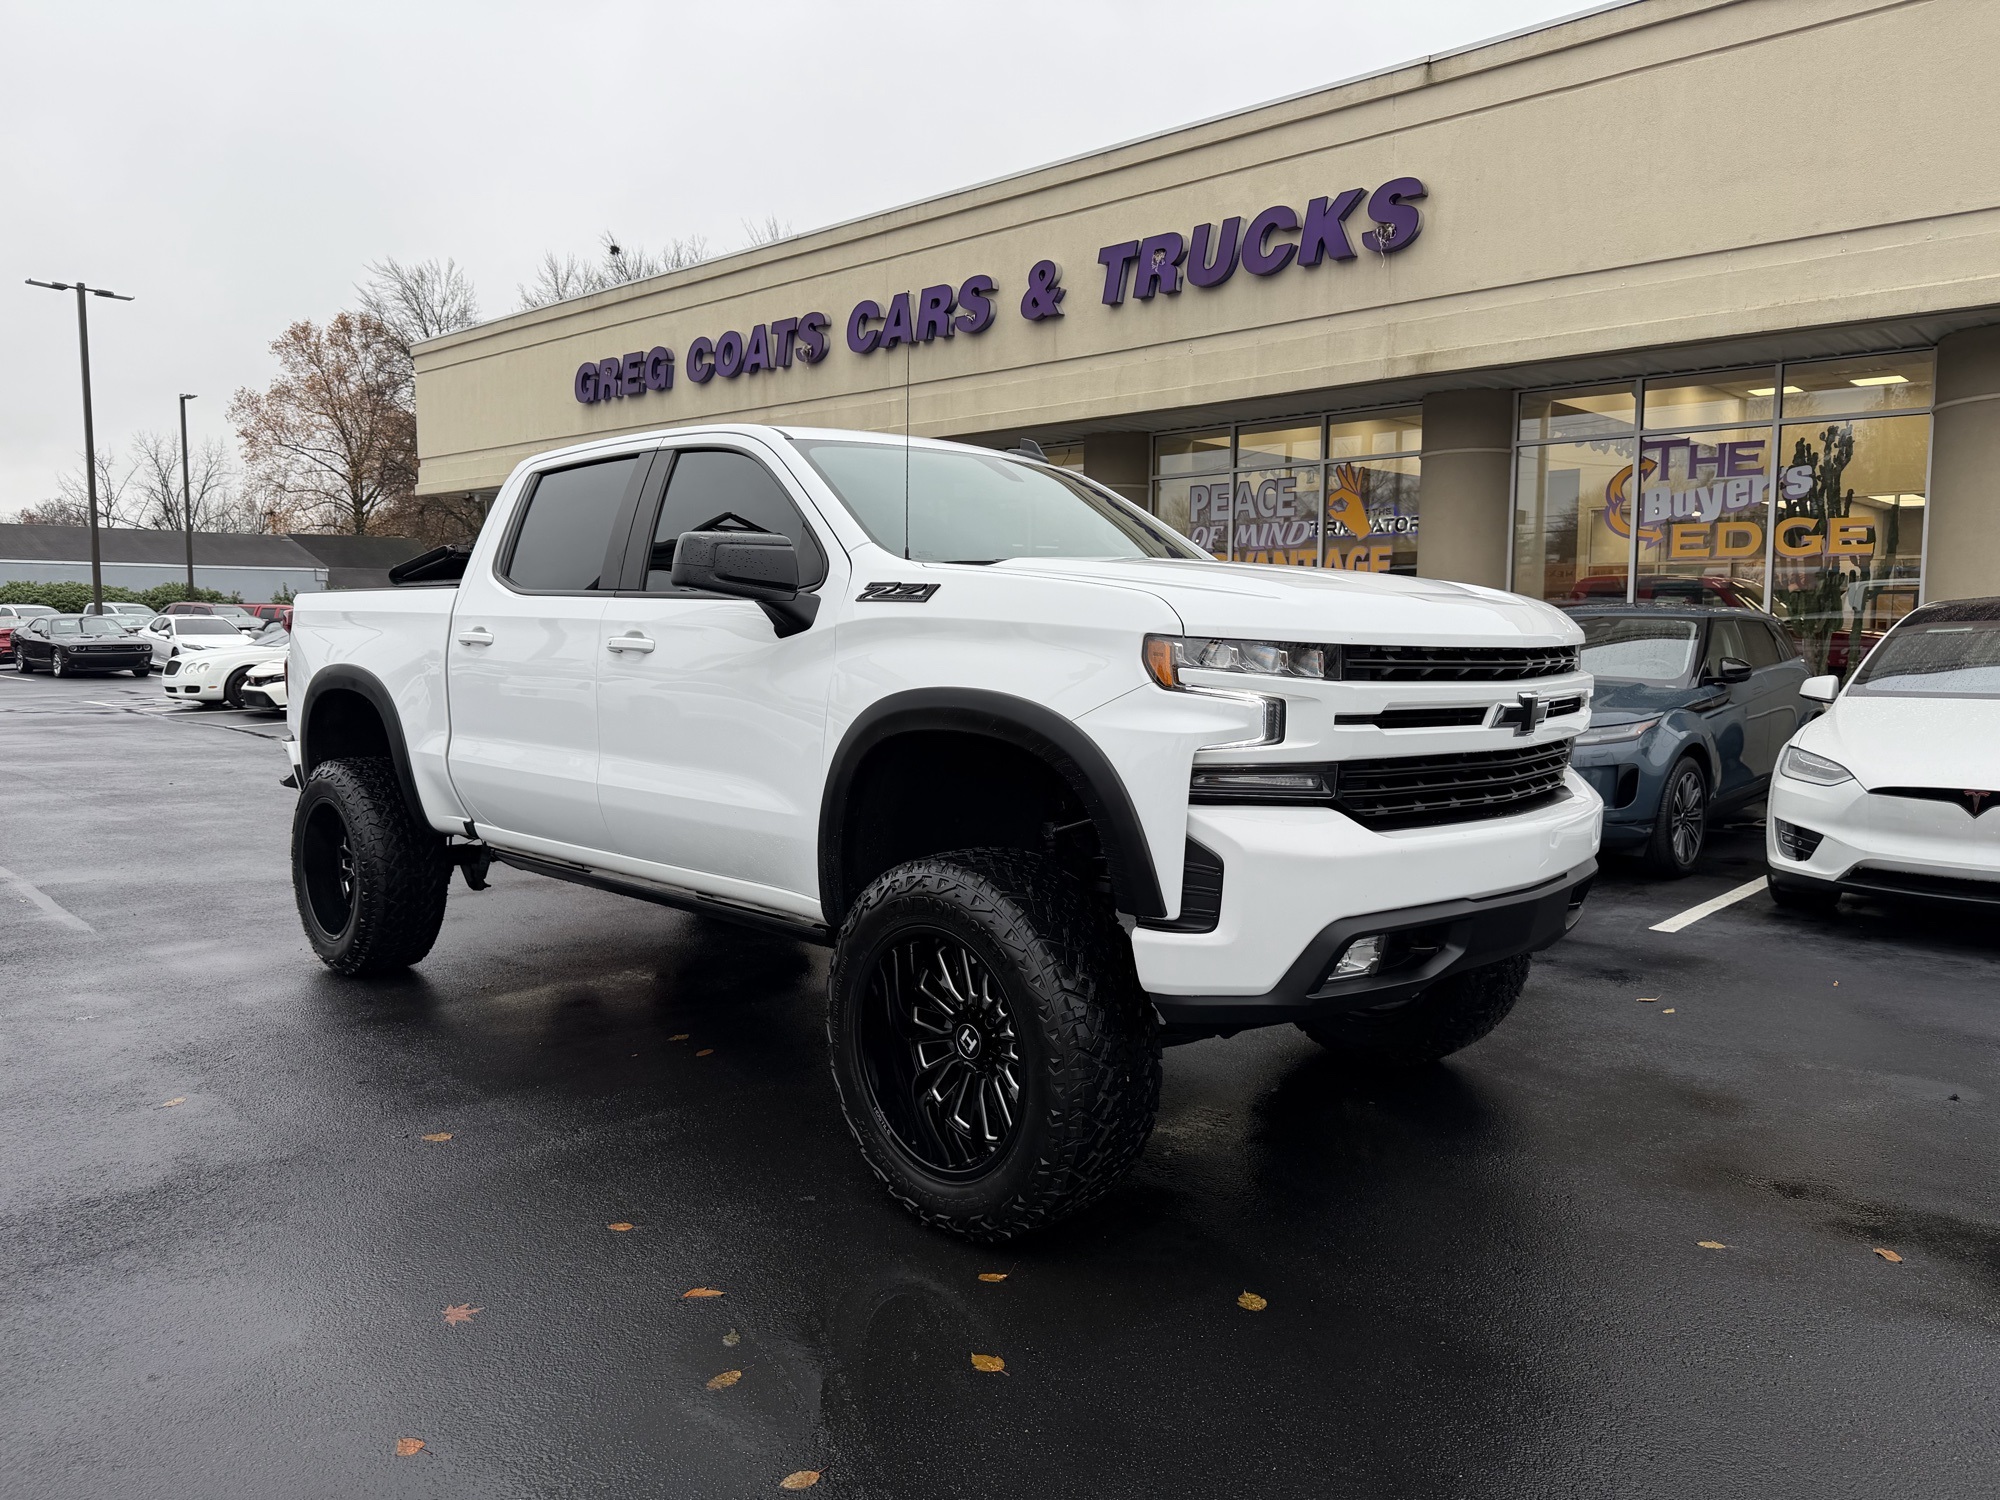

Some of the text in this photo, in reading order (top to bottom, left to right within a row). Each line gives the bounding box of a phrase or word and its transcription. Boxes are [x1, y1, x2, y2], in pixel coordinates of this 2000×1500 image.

[575, 176, 1429, 404] GREG COATS CARS & TRUCKS
[1642, 436, 1766, 481] THE
[1189, 476, 1297, 523] PEACE
[1191, 519, 1311, 550] OF MIND
[1670, 516, 1876, 559] EDGE
[855, 582, 942, 603] Z71
